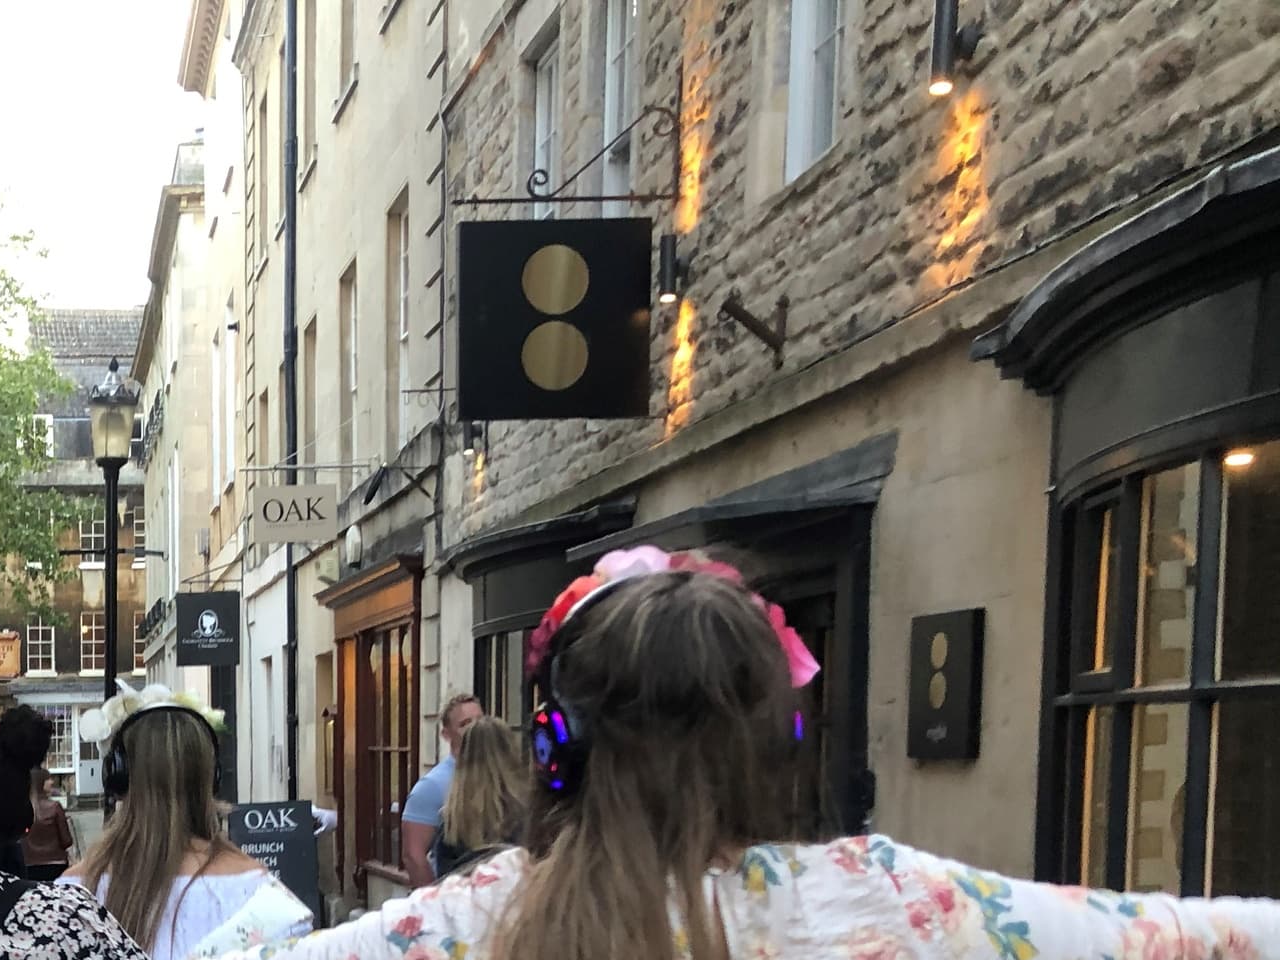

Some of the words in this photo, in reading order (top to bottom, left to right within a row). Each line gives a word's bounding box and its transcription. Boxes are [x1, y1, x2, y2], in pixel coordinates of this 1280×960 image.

[262, 497, 327, 523] OAK
[244, 807, 298, 830] OAK
[241, 841, 284, 854] BRUNCH
